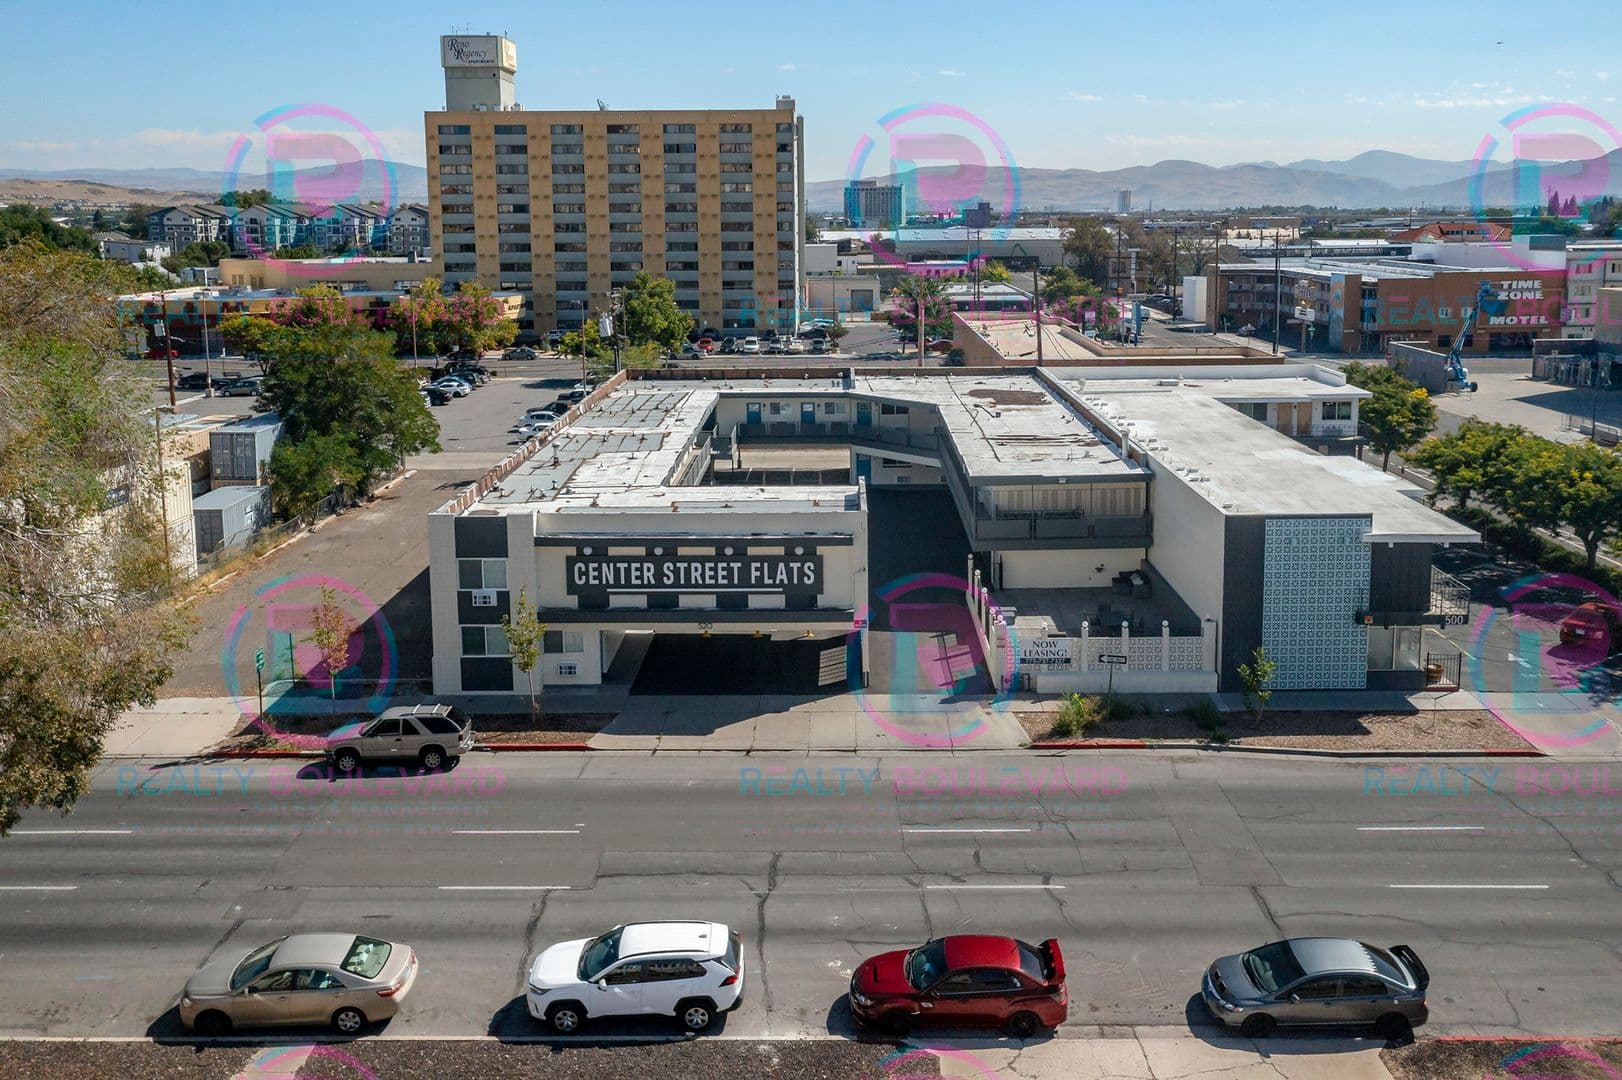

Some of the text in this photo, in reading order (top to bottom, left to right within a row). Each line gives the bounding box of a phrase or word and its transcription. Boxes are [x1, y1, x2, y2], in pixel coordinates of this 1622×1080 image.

[1500, 280, 1542, 289] TIME
[1497, 291, 1544, 300] ZONE
[1489, 315, 1549, 325] MOTEL
[574, 561, 816, 585] CENTER STREET FLATS
[1445, 615, 1464, 625] 500
[1032, 640, 1059, 649] NOW
[1023, 649, 1068, 657] LEASING!
